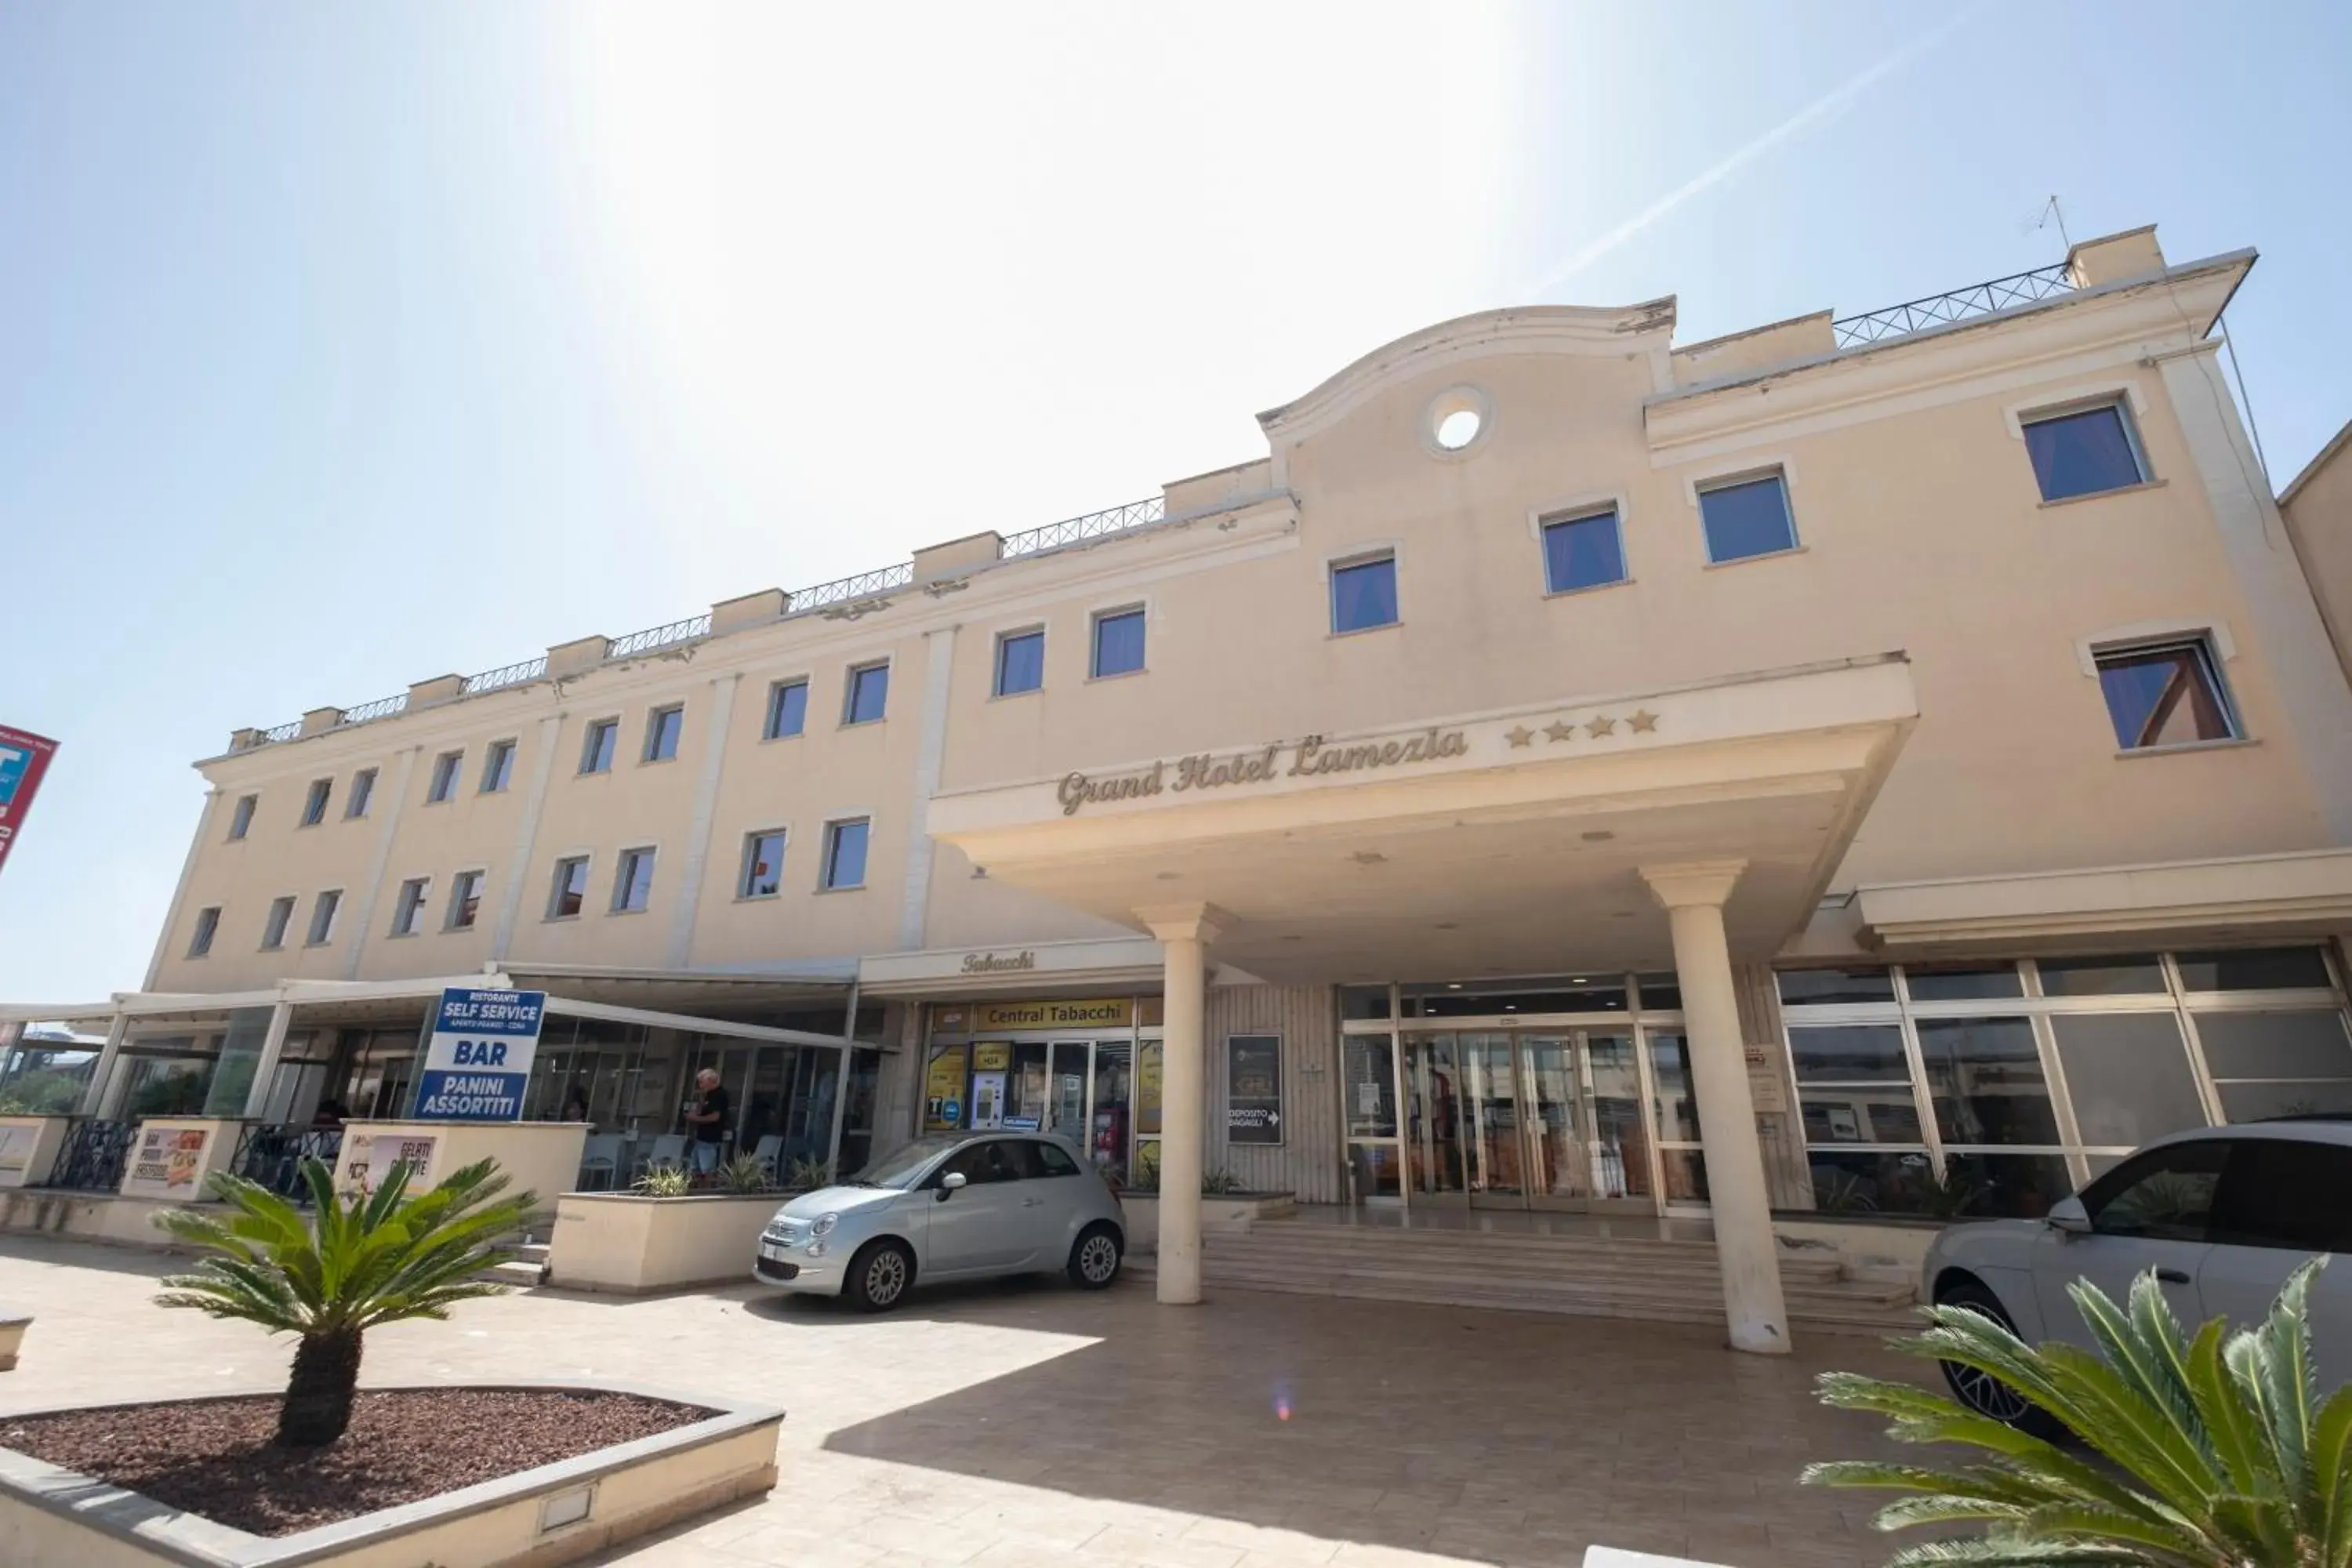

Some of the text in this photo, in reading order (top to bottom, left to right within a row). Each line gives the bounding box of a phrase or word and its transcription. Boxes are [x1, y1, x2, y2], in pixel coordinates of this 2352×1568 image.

[1058, 727, 1468, 815] Grand Hotel Lamezia
[960, 951, 1035, 973] Tabacchi
[470, 992, 520, 1003] RISTORANTE
[445, 1002, 539, 1020] SELF SERVICE
[988, 1004, 1121, 1023] Central Tabacchi
[453, 1040, 507, 1066] BAR
[443, 1076, 505, 1095] PANINI
[422, 1094, 515, 1115] ASSORTITI
